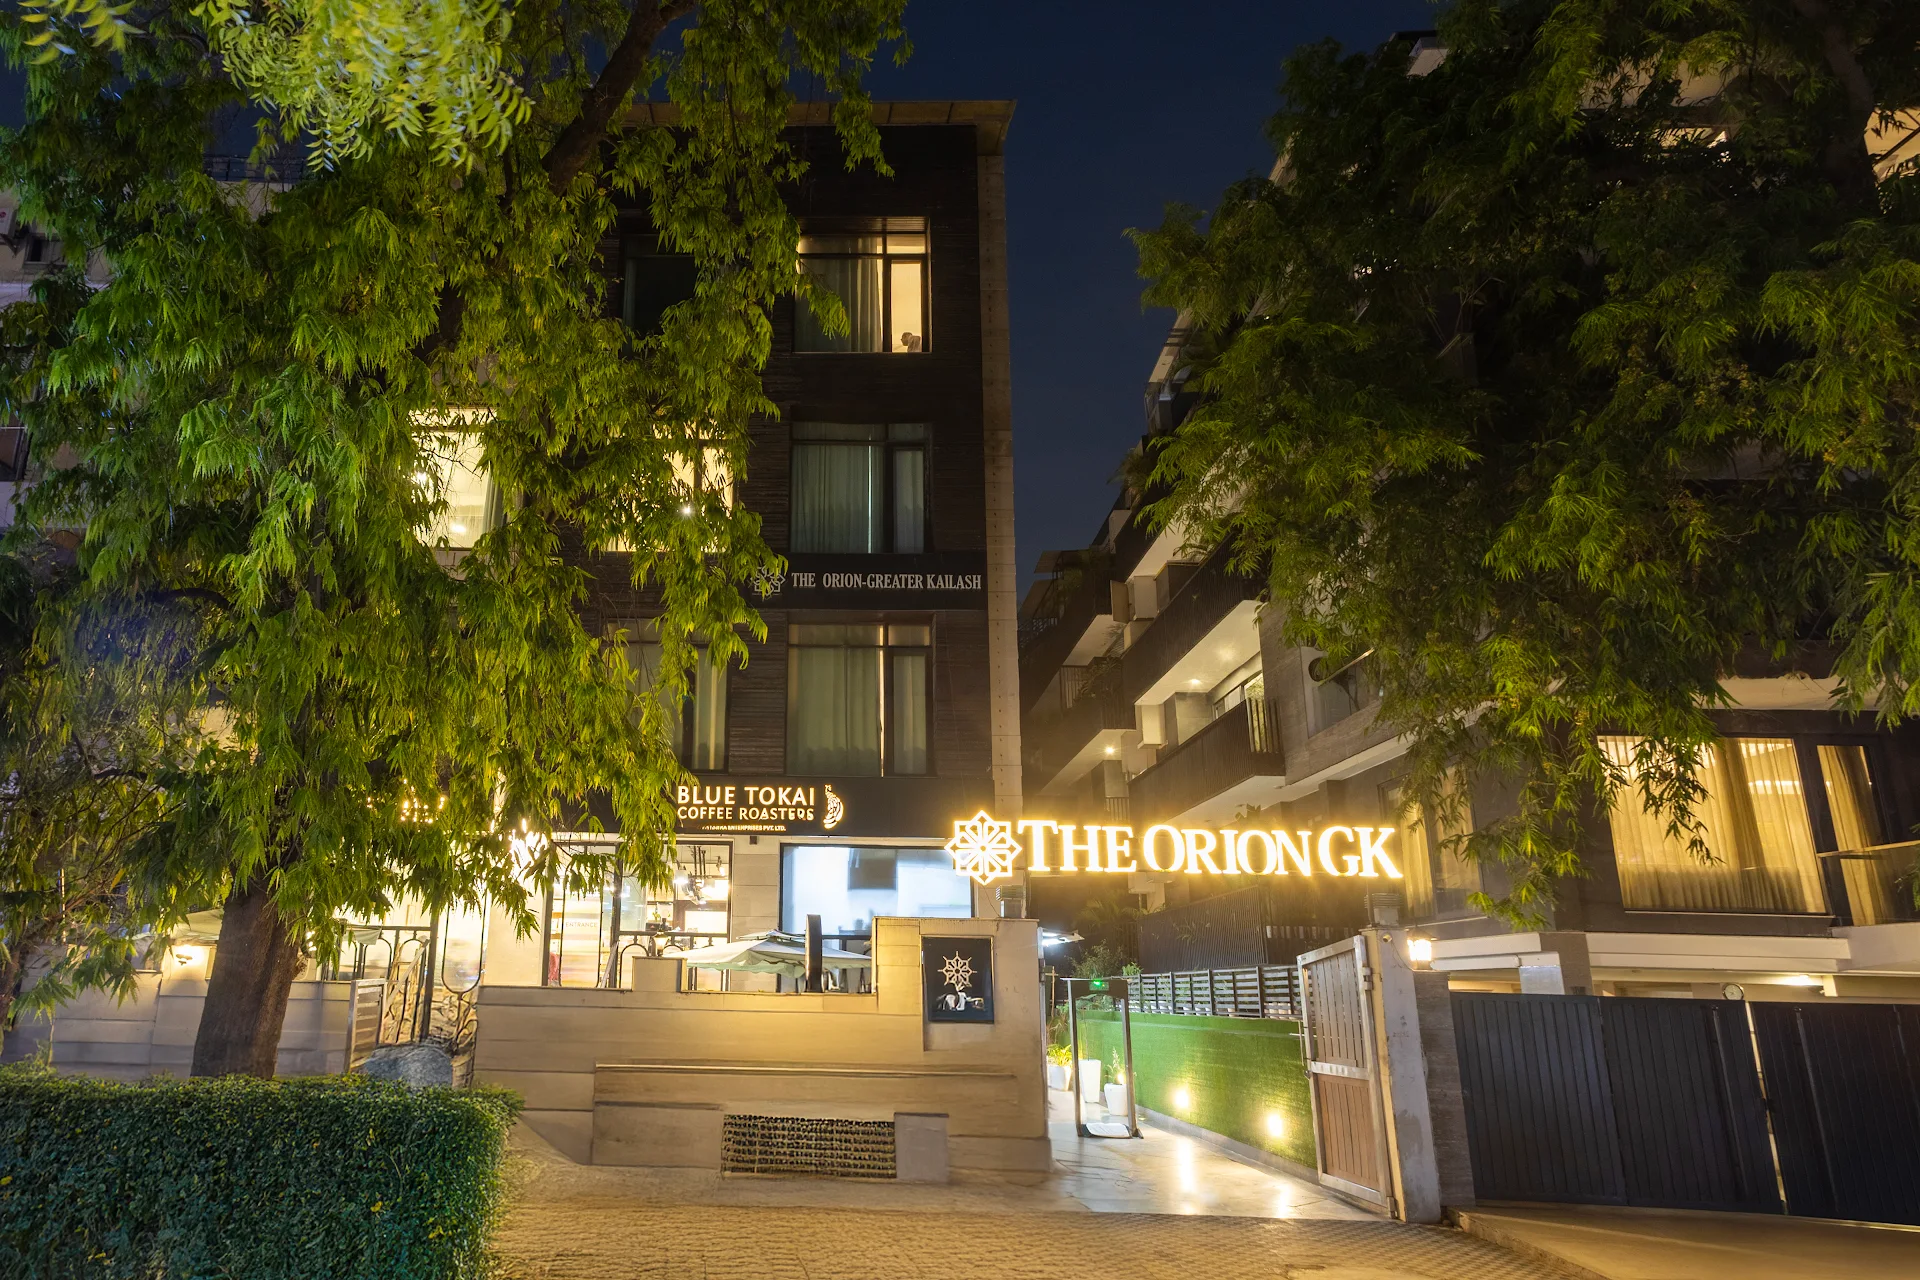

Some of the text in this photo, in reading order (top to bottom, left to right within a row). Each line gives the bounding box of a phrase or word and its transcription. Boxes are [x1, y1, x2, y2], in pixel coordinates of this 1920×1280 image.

[791, 572, 982, 590] THE ORION-GREATER KAILASH
[677, 785, 815, 806] BLUE TOKAI
[677, 806, 815, 821] COFFEE ROASTERS
[1017, 819, 1404, 879] THE ORION GK
